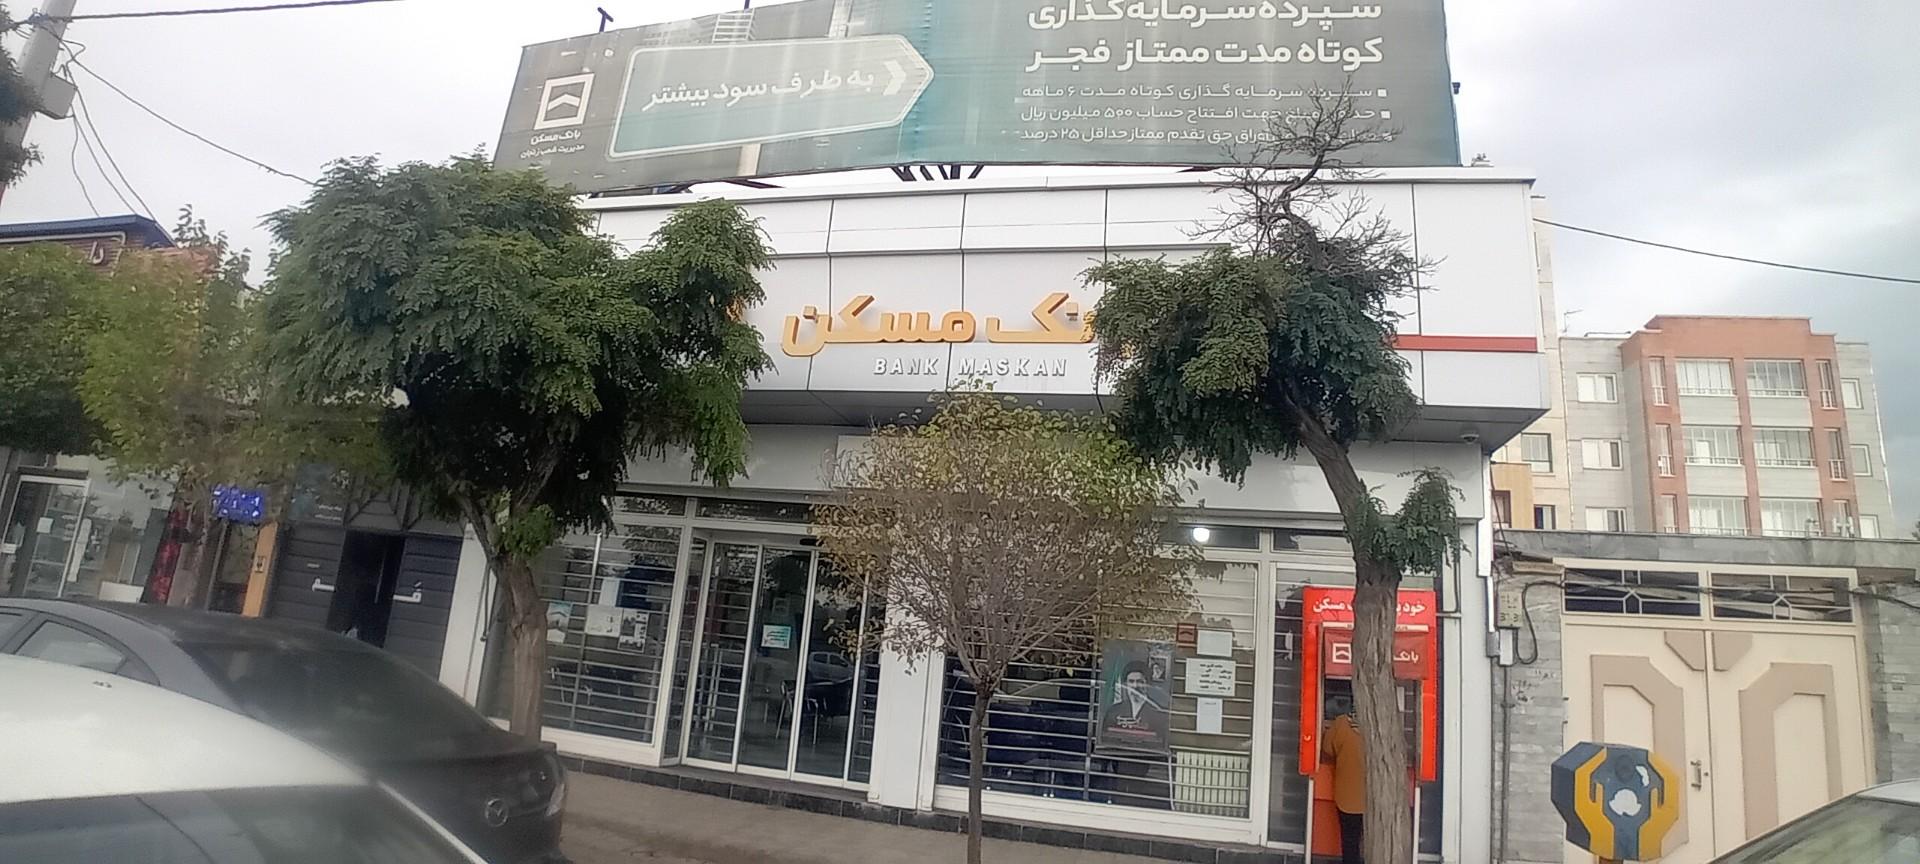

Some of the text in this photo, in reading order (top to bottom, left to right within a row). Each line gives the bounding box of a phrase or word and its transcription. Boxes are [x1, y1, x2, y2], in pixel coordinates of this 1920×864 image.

[1126, 0, 1256, 29] سرمایه
[1258, 0, 1383, 31] سپرده
[1025, 36, 1384, 73] کوتاه مدت ممتاز فجر
[641, 69, 874, 112] به طرف سود بیشتر
[1022, 85, 1064, 98] ماهه
[1080, 86, 1126, 98] مدت
[1129, 84, 1175, 100] کوتاه
[1178, 82, 1231, 101] گذاری
[1234, 84, 1303, 101] سرمایه
[1021, 105, 1046, 122] ریال
[1049, 105, 1101, 121] میلیون
[1103, 107, 1133, 119] ۵۰۰
[1136, 106, 1184, 123] حساب
[1187, 106, 1238, 123] افتتاح
[1241, 109, 1282, 122] جهت
[1020, 128, 1058, 142] درصد
[1061, 128, 1080, 139] ۲۵
[1082, 127, 1128, 142] حداقل
[1128, 128, 1165, 142] ممتاز
[1167, 129, 1205, 142] تقدم
[1208, 129, 1233, 144] حق
[780, 294, 977, 358] مسکن
[873, 357, 1067, 378] BANK MASKAN
[1313, 597, 1346, 613] مسکن
